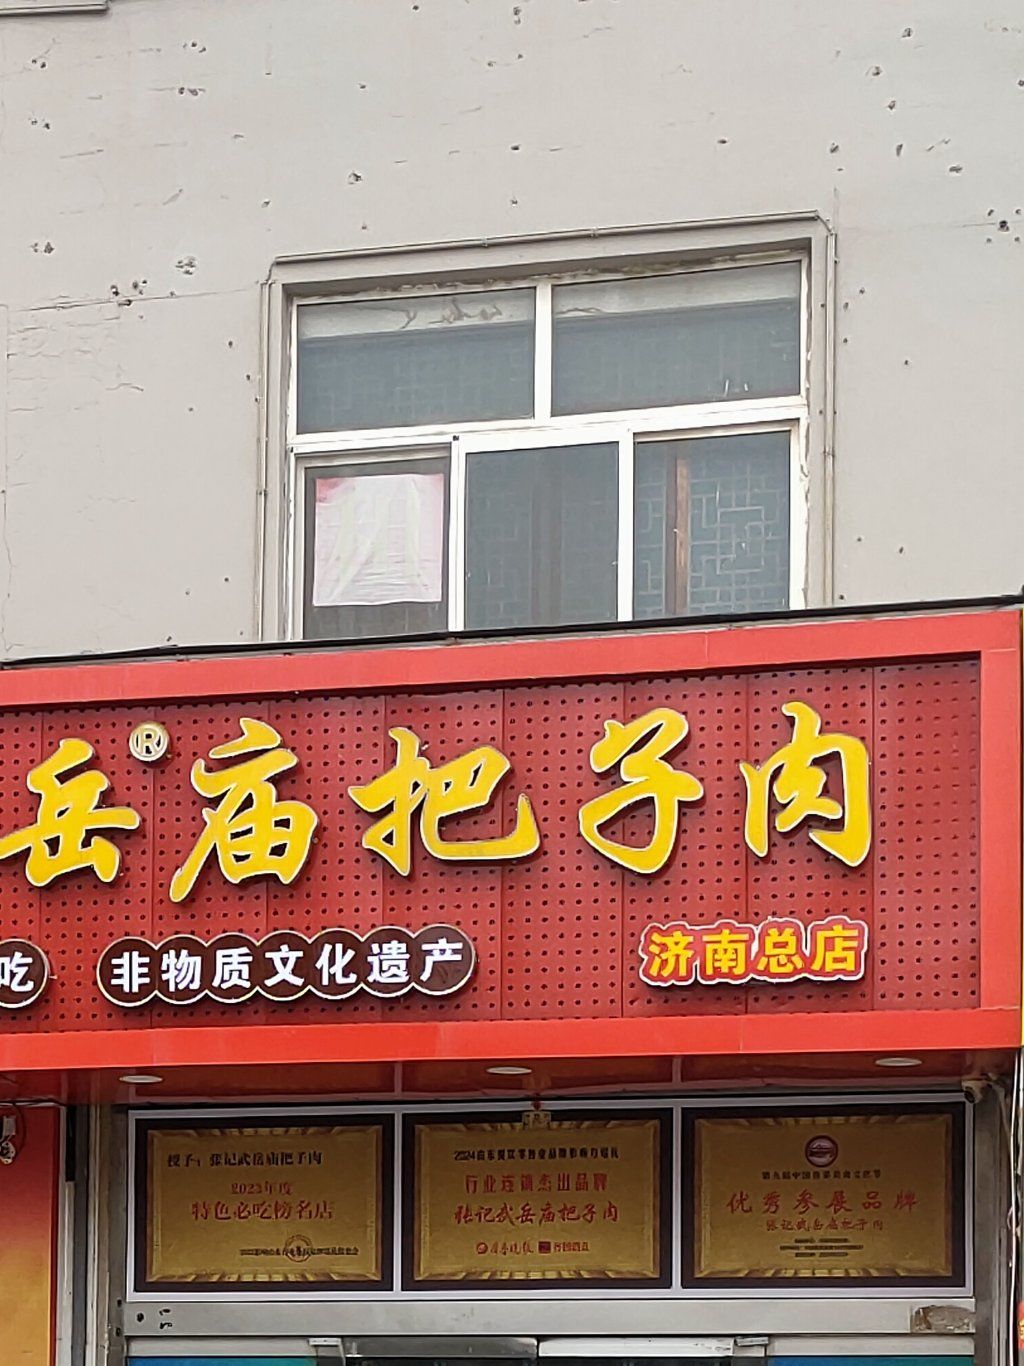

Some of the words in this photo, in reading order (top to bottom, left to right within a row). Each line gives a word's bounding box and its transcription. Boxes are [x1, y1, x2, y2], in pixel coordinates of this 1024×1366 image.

[647, 924, 860, 976] 济南总店
[110, 937, 464, 992] 非物质文化遗产
[231, 1181, 292, 1196] 2023年度
[465, 1173, 608, 1194] 行业连锁杰出品牌
[192, 1201, 334, 1220] 特色必吃榜名店
[454, 1201, 620, 1227] 张记武岳庙把子肉
[726, 1188, 919, 1214] 优秀参展品牌
